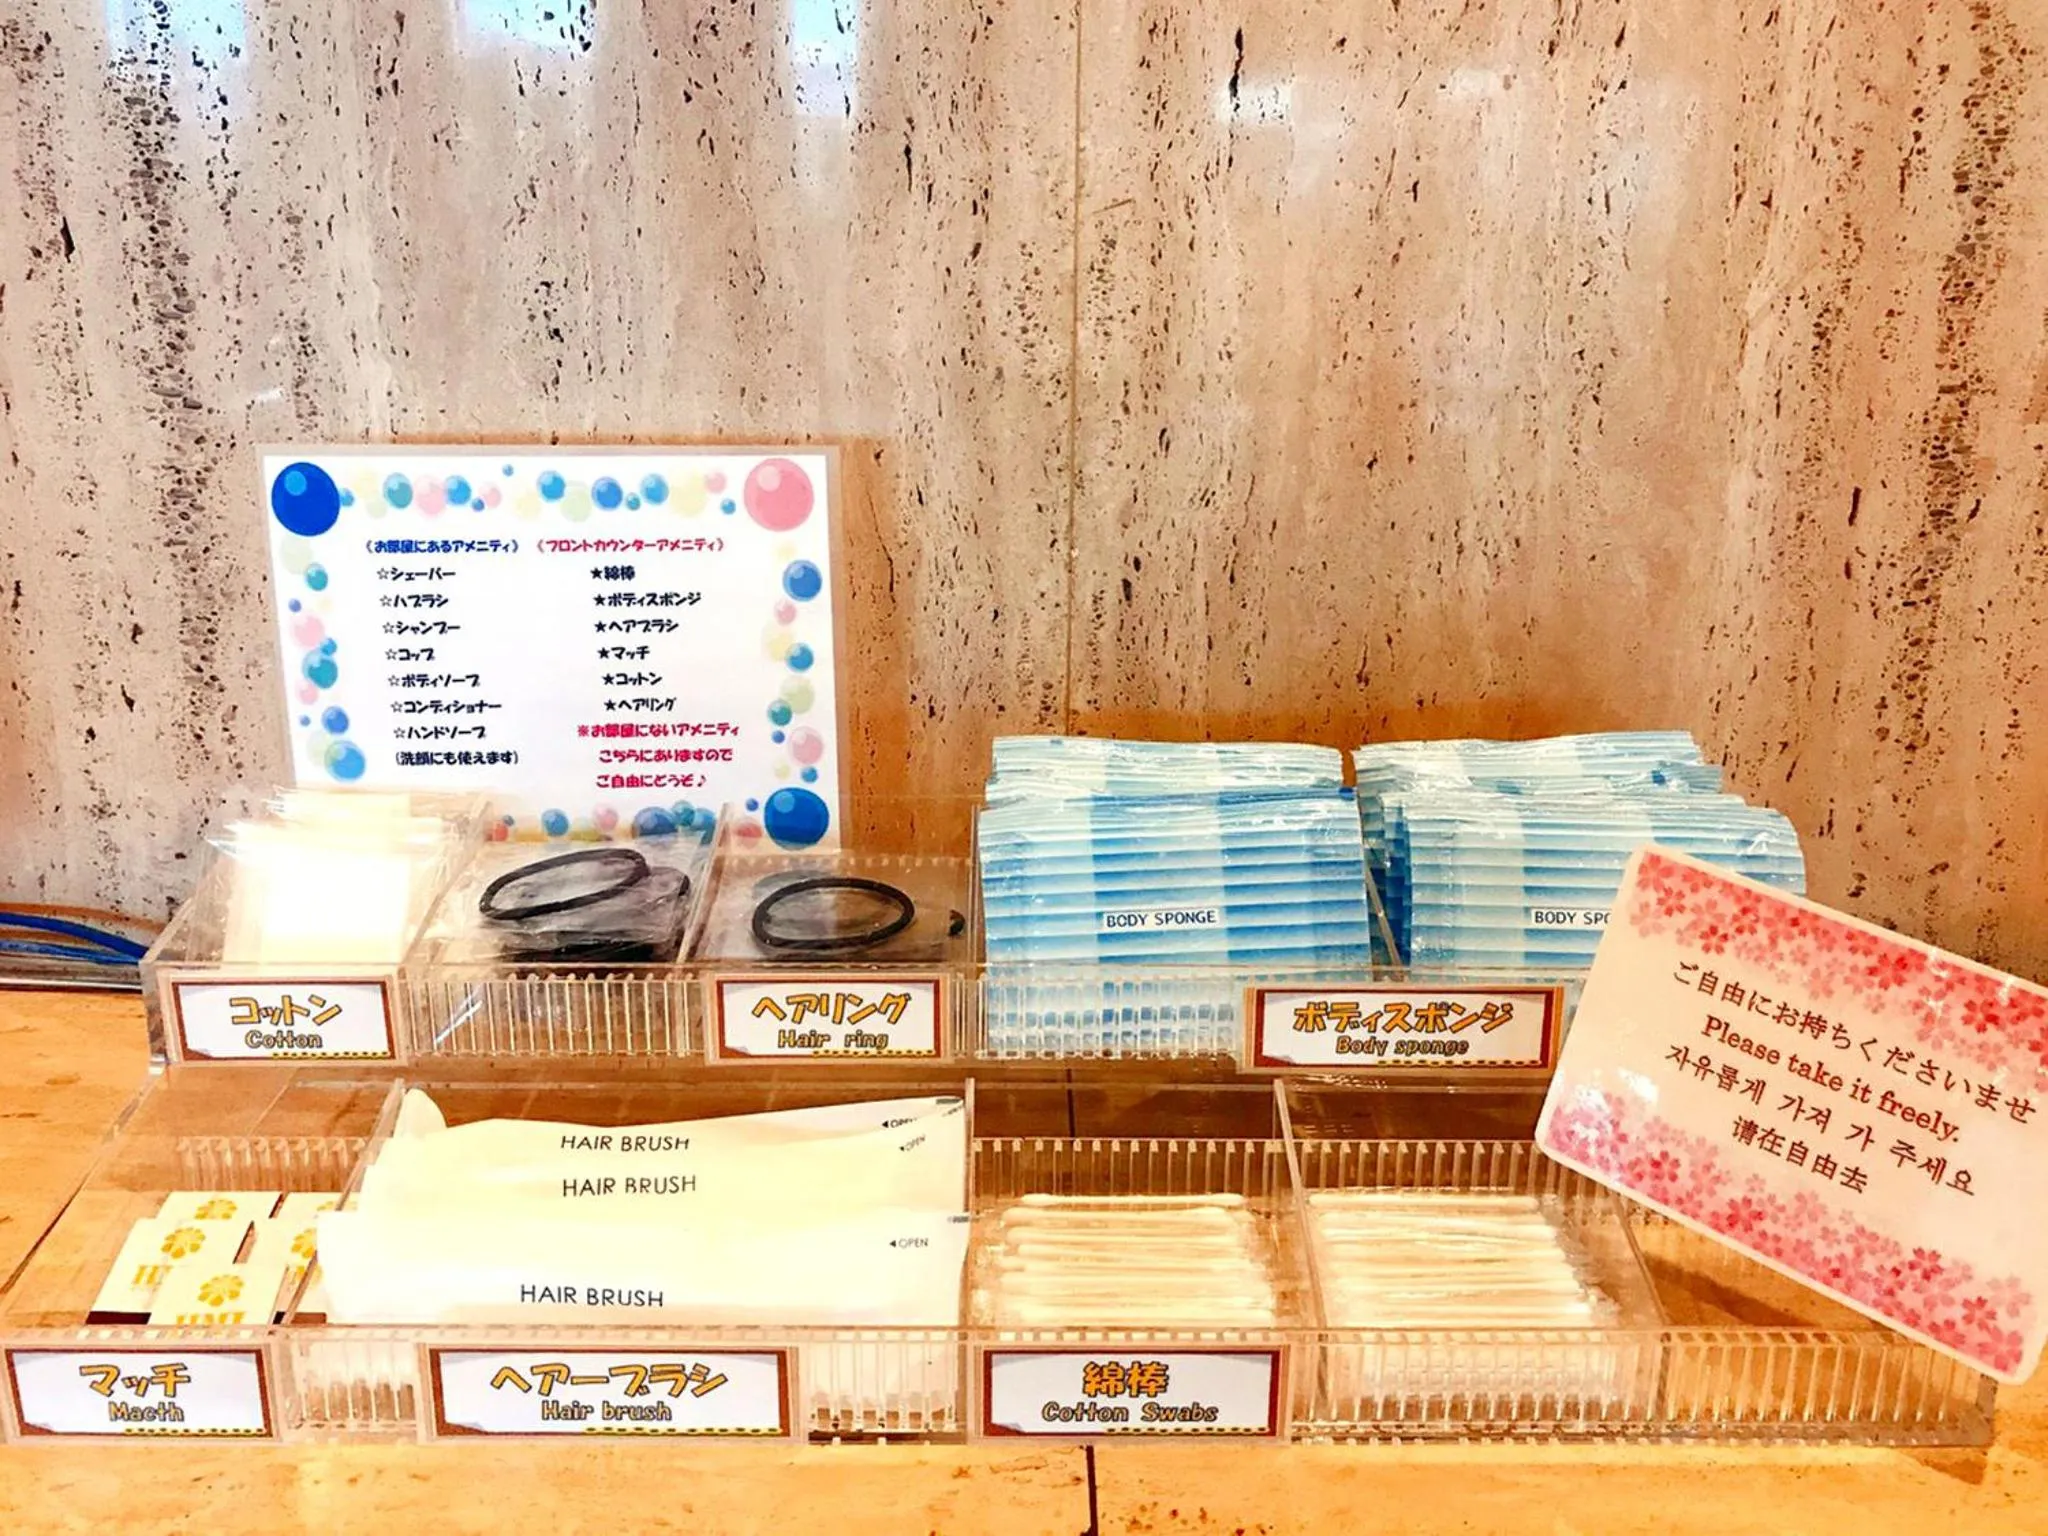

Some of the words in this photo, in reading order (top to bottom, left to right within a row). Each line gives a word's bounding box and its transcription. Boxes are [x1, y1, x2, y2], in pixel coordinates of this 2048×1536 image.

[390, 566, 456, 581] シェーバー
[393, 593, 449, 608] ハブラシ
[396, 620, 461, 635] シャンプー
[608, 618, 679, 633] ヘアブラシ
[398, 647, 435, 661] コップ
[611, 645, 650, 660] マッチ
[615, 672, 663, 686] コットン
[403, 699, 502, 714] コンディショナー
[617, 697, 677, 712] ヘアリング
[407, 726, 486, 740] ハンドソープ
[598, 748, 733, 763] こちらにありますので
[1106, 913, 1149, 928] BODY
[1154, 910, 1217, 926] SPONGE
[1534, 911, 1577, 925] BODY
[229, 994, 343, 1026] コットン
[751, 992, 912, 1025] ヘアリング
[1293, 1001, 1514, 1034] ボディスポンジ
[245, 1029, 324, 1049] Cotton
[778, 1028, 831, 1049] Hair
[844, 1030, 889, 1050] ring
[1335, 1035, 1389, 1057] Body
[1393, 1039, 1470, 1058] sponge
[1672, 960, 2038, 1126] ご自由にお持ちくださいませ
[1700, 1014, 1782, 1067] Please
[1787, 1053, 1844, 1093] take
[1848, 1077, 1872, 1105] it
[1876, 1090, 1961, 1145] freely.
[1664, 1044, 1767, 1106] 자유롭게
[1777, 1092, 1833, 1135] 가져
[1844, 1122, 1876, 1153] 가
[1888, 1138, 1976, 1197] 주세요
[560, 1135, 613, 1151] HAIR
[620, 1135, 690, 1152] BRUSH
[1731, 1115, 1870, 1195] 请在自由去
[562, 1177, 616, 1197] HAIR
[625, 1174, 696, 1195] BRUSH
[898, 1238, 929, 1249] OPEN
[520, 1283, 578, 1304] HAIR
[586, 1287, 664, 1308] BRUSH
[79, 1362, 191, 1398] マッチ
[490, 1363, 728, 1398] ヘアーブラシ
[1082, 1361, 1169, 1398] 綿棒
[108, 1401, 185, 1422] Macth
[541, 1400, 594, 1421] Hair
[602, 1400, 672, 1421] brush
[1042, 1401, 1129, 1422] Cotton
[1140, 1401, 1219, 1422] Swabs
